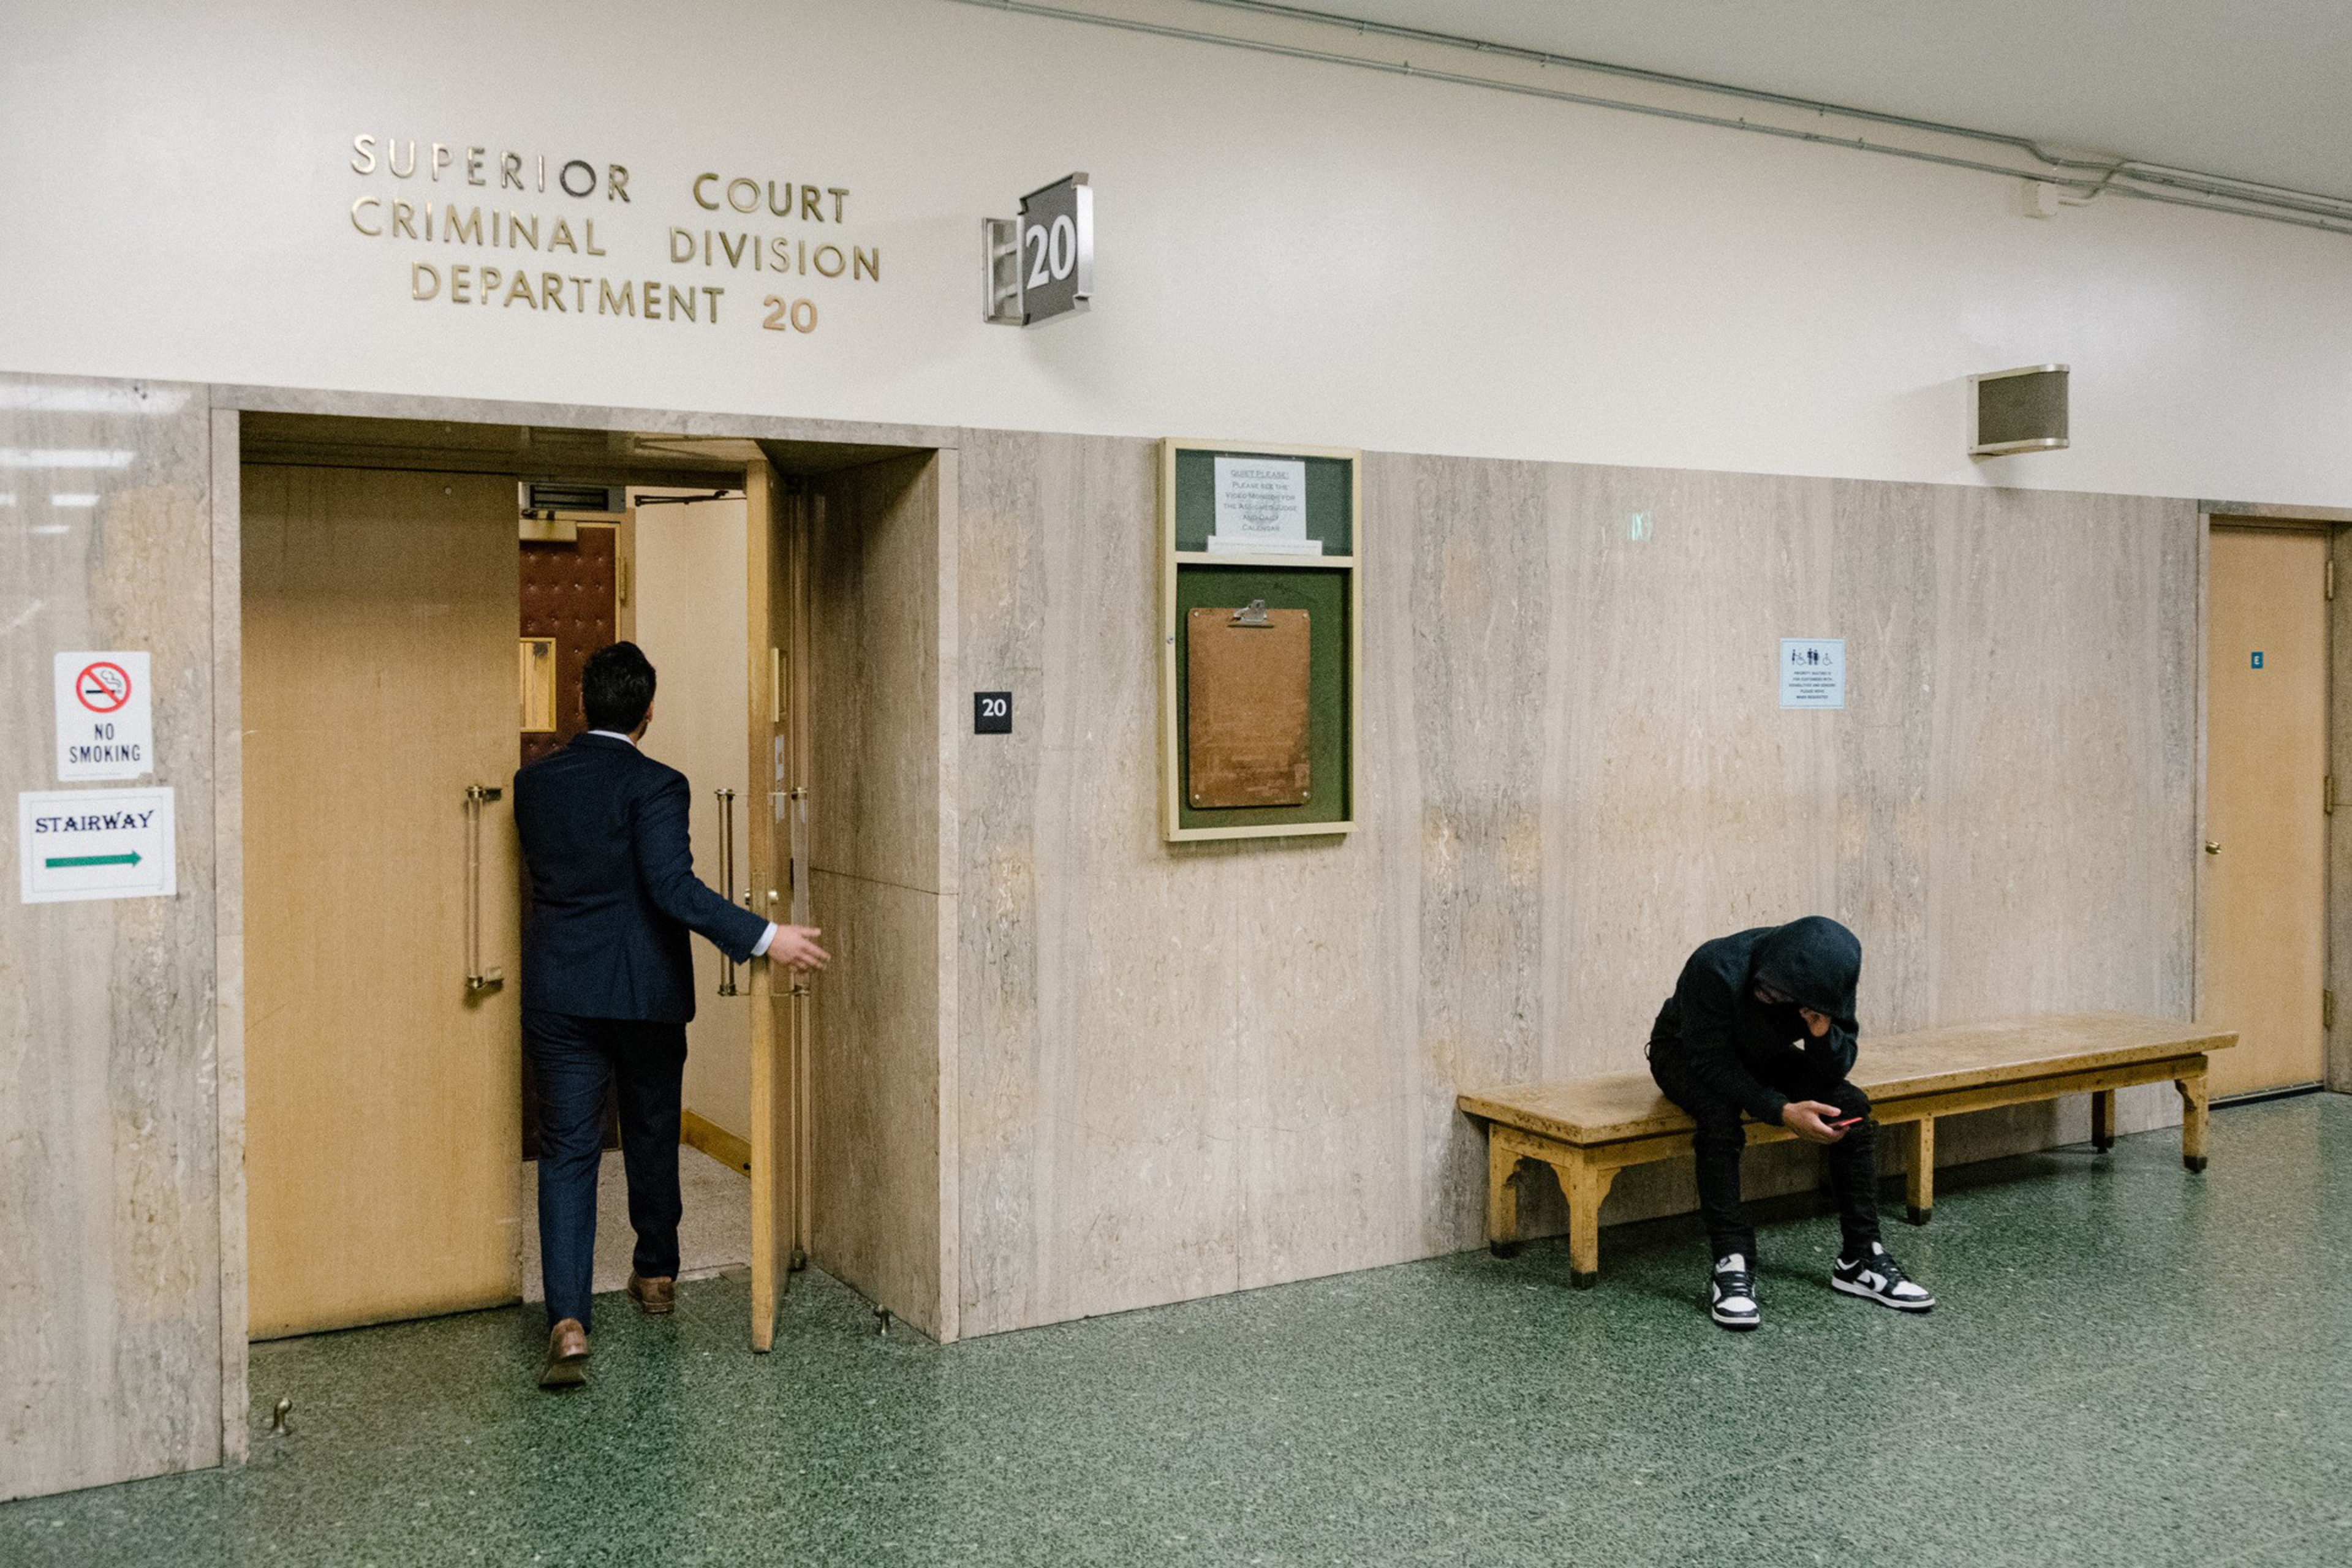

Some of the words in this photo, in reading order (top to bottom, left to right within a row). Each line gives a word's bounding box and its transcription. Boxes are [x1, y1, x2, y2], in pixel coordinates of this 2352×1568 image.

[350, 133, 631, 203] SUPERIOR
[692, 172, 850, 224] COURT
[350, 195, 607, 256] CRIMINAL
[669, 225, 880, 282] DIVISION
[1026, 214, 1076, 290] 20
[411, 260, 725, 323] DEPARTMENT
[762, 293, 819, 334] 20
[2254, 655, 2259, 665] E
[981, 698, 1007, 717] 20
[94, 723, 115, 741] NO
[69, 744, 141, 764] SMOKING
[35, 809, 155, 833] STAIRWAY
